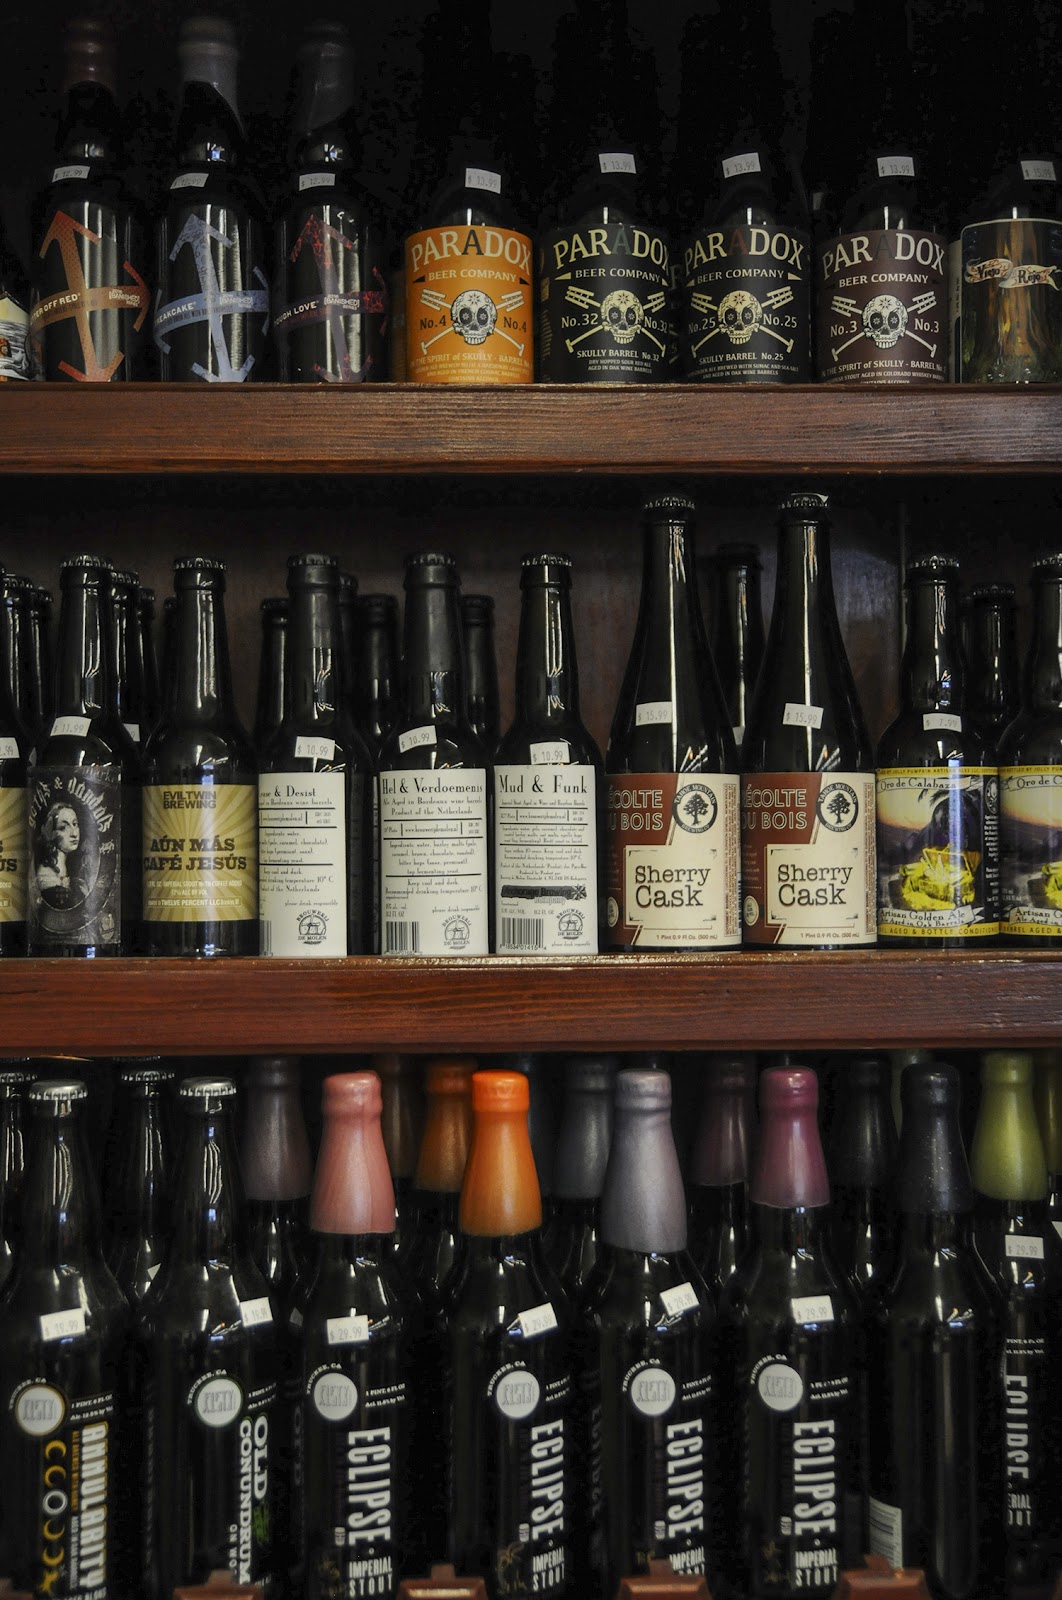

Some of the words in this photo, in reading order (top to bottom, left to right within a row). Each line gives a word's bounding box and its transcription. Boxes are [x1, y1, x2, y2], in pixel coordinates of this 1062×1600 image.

[734, 161, 755, 172] 13.99
[890, 164, 910, 174] 13.99
[477, 176, 497, 188] 13.99
[411, 230, 530, 275] PARADOX
[685, 228, 804, 277] PARADOX
[822, 232, 943, 280] PARADOX
[428, 270, 457, 281] BEER
[460, 268, 517, 282] COMPANY
[575, 268, 606, 278] BEER
[610, 268, 660, 283] COMPANY
[697, 271, 722, 285] BEER
[726, 269, 784, 279] COMPANY
[839, 276, 868, 288] BEER
[871, 273, 928, 283] COMPANY
[43, 299, 58, 312] OFF
[59, 293, 78, 304] RED
[294, 301, 317, 314] LOVE
[420, 315, 446, 330] No.4
[504, 316, 526, 332] No.4
[561, 313, 598, 328] No.32
[644, 316, 668, 333] No.32
[688, 316, 716, 333] No.25
[763, 313, 797, 328] No.25
[831, 321, 857, 337] No.3
[915, 318, 939, 333] No.3
[427, 354, 450, 362] SPIRIT
[462, 353, 492, 361] SKULLY
[499, 355, 523, 364] BARREL
[577, 350, 607, 358] SKULLY
[609, 350, 639, 358] BARREL
[642, 352, 659, 362] No.32
[699, 355, 723, 366] SKULLY
[726, 353, 757, 361] BARREL
[761, 353, 784, 361] No.25
[838, 363, 861, 372] SPIRIT
[864, 361, 872, 369] of
[910, 361, 935, 370] BARREL
[646, 711, 667, 720] 15.99
[795, 712, 817, 724] 15.99
[939, 718, 958, 727] 7.99
[62, 724, 84, 733] 11.99
[409, 733, 429, 745] 10.99
[307, 745, 328, 756] 10.99
[542, 750, 563, 761] 10.99
[54, 777, 63, 790] &
[274, 785, 281, 796] &
[287, 785, 316, 796] Desist
[382, 778, 396, 795] Hel
[400, 778, 408, 793] &
[414, 778, 482, 794] Verdoemenis
[499, 775, 524, 793] Mud
[532, 775, 544, 793] &
[553, 775, 587, 793] Funk
[880, 780, 894, 791] Oro
[896, 779, 905, 787] de
[908, 777, 957, 789] Calabaza
[1017, 778, 1032, 788] Oro
[1038, 776, 1049, 785] de
[608, 785, 663, 808] ÉCOLTE
[674, 785, 691, 804] TAHOE
[691, 784, 715, 804] MOUNTAIN
[744, 784, 806, 808] ÉCOLTE
[818, 785, 834, 803] TAHOE
[835, 783, 857, 803] MOUNTAIN
[163, 801, 216, 809] BREWING
[392, 798, 405, 806] Aged
[620, 812, 663, 831] BOIS
[761, 811, 807, 830] BOIS
[150, 835, 185, 852] AÚN
[190, 835, 235, 852] MÁS
[144, 854, 182, 870] CAFÉ
[186, 854, 247, 870] JESÚS
[635, 865, 711, 886] Sherry
[778, 864, 853, 884] Sherry
[636, 885, 703, 908] Cask
[778, 883, 846, 906] Cask
[296, 910, 330, 922] BROUWERIJ
[442, 914, 472, 927] BROUWERIJ
[556, 908, 585, 919] BROUWERIJ
[910, 911, 944, 921] Golden
[948, 910, 965, 920] Ale
[1016, 910, 1050, 918] Artisan
[1016, 1245, 1037, 1256] 29.99
[806, 1306, 827, 1320] 29.99
[339, 1326, 361, 1340] 29.99
[306, 1363, 330, 1394] TRUCKEE,
[487, 1363, 513, 1396] TRUCKEE,
[187, 1372, 215, 1405] TRUCKEE,
[254, 1415, 268, 1500] OLD
[531, 1419, 564, 1540] ECLIPSE
[667, 1418, 704, 1538] ECLIPSE
[793, 1419, 836, 1535] ECLIPSE
[348, 1427, 391, 1546] ECLIPSE
[80, 1421, 108, 1588] ANNULARITY
[239, 1419, 252, 1585] CONUNDRUM
[230, 1524, 238, 1542] ON
[533, 1546, 564, 1573] IMPERIAL
[669, 1546, 705, 1571] IMPERIAL
[795, 1547, 838, 1568] IMPERIAL
[349, 1556, 392, 1578] IMPERIAL
[533, 1563, 564, 1592] STOUT
[795, 1565, 837, 1587] STOUT
[350, 1574, 392, 1598] STOUT
